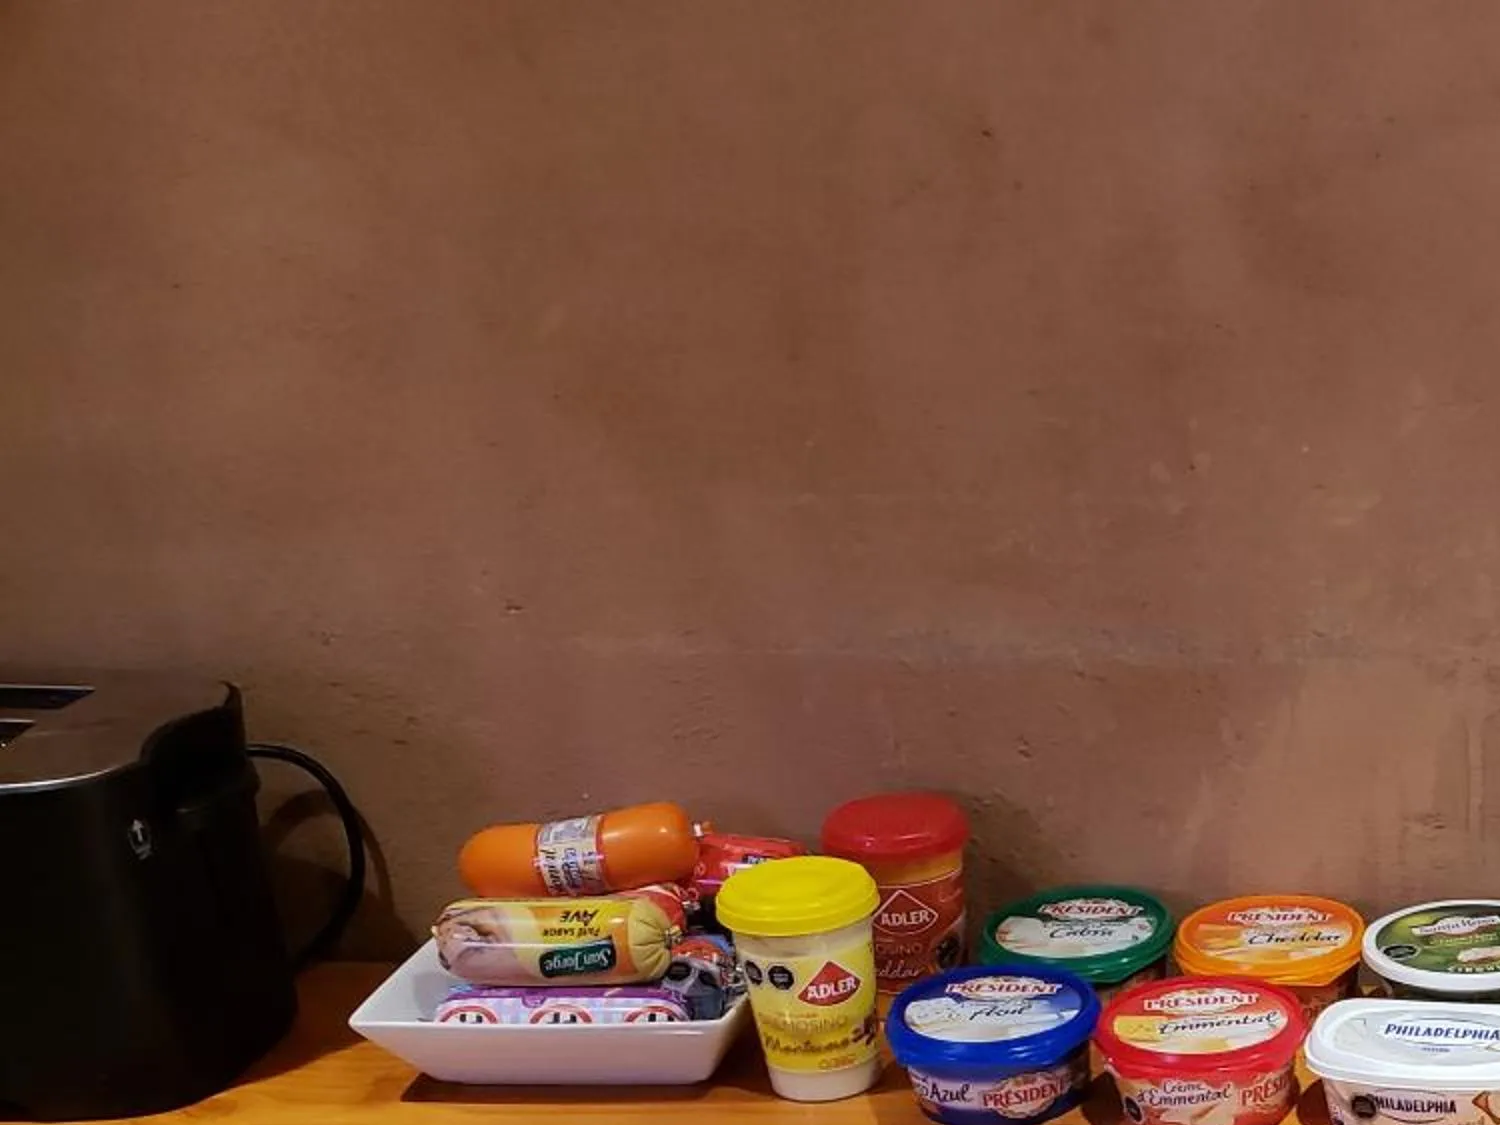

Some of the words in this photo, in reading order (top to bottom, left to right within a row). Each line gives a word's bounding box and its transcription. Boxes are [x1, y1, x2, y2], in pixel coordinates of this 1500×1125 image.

[880, 909, 931, 927] ADLER
[543, 951, 584, 971] Jorge
[584, 948, 612, 968] San
[806, 976, 857, 1000] ADLER
[929, 1082, 974, 1103] Azul
